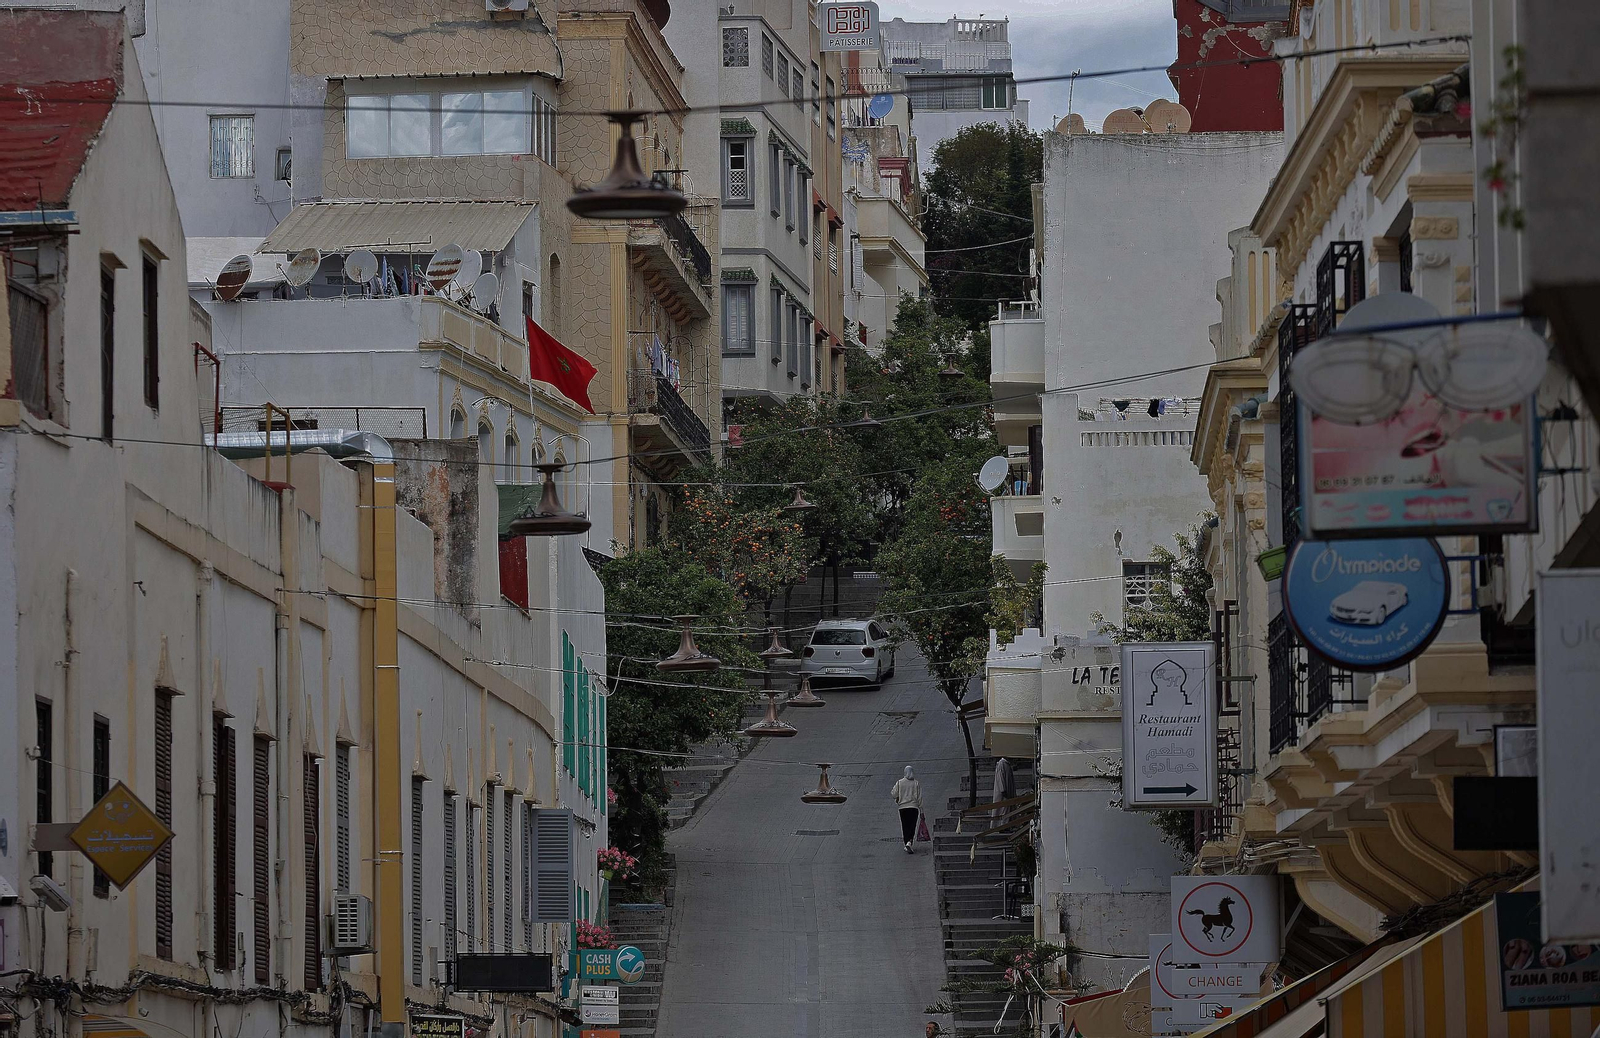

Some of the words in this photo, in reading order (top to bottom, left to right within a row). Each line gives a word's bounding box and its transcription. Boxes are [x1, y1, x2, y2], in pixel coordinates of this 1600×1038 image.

[1072, 667, 1091, 685] LA
[1100, 666, 1120, 685] TE
[1095, 686, 1121, 695] REST
[1139, 713, 1202, 724] Restaurant
[1147, 726, 1194, 737] Hamadi
[1146, 743, 1195, 761] مطعم
[1141, 758, 1199, 778] حمادي
[586, 953, 611, 964] CASH
[586, 964, 611, 975] PLUS
[1188, 976, 1243, 988] CHANGE
[1510, 973, 1548, 987] ZIANA
[1552, 971, 1578, 985] ROA
[1582, 969, 1600, 983] BE
